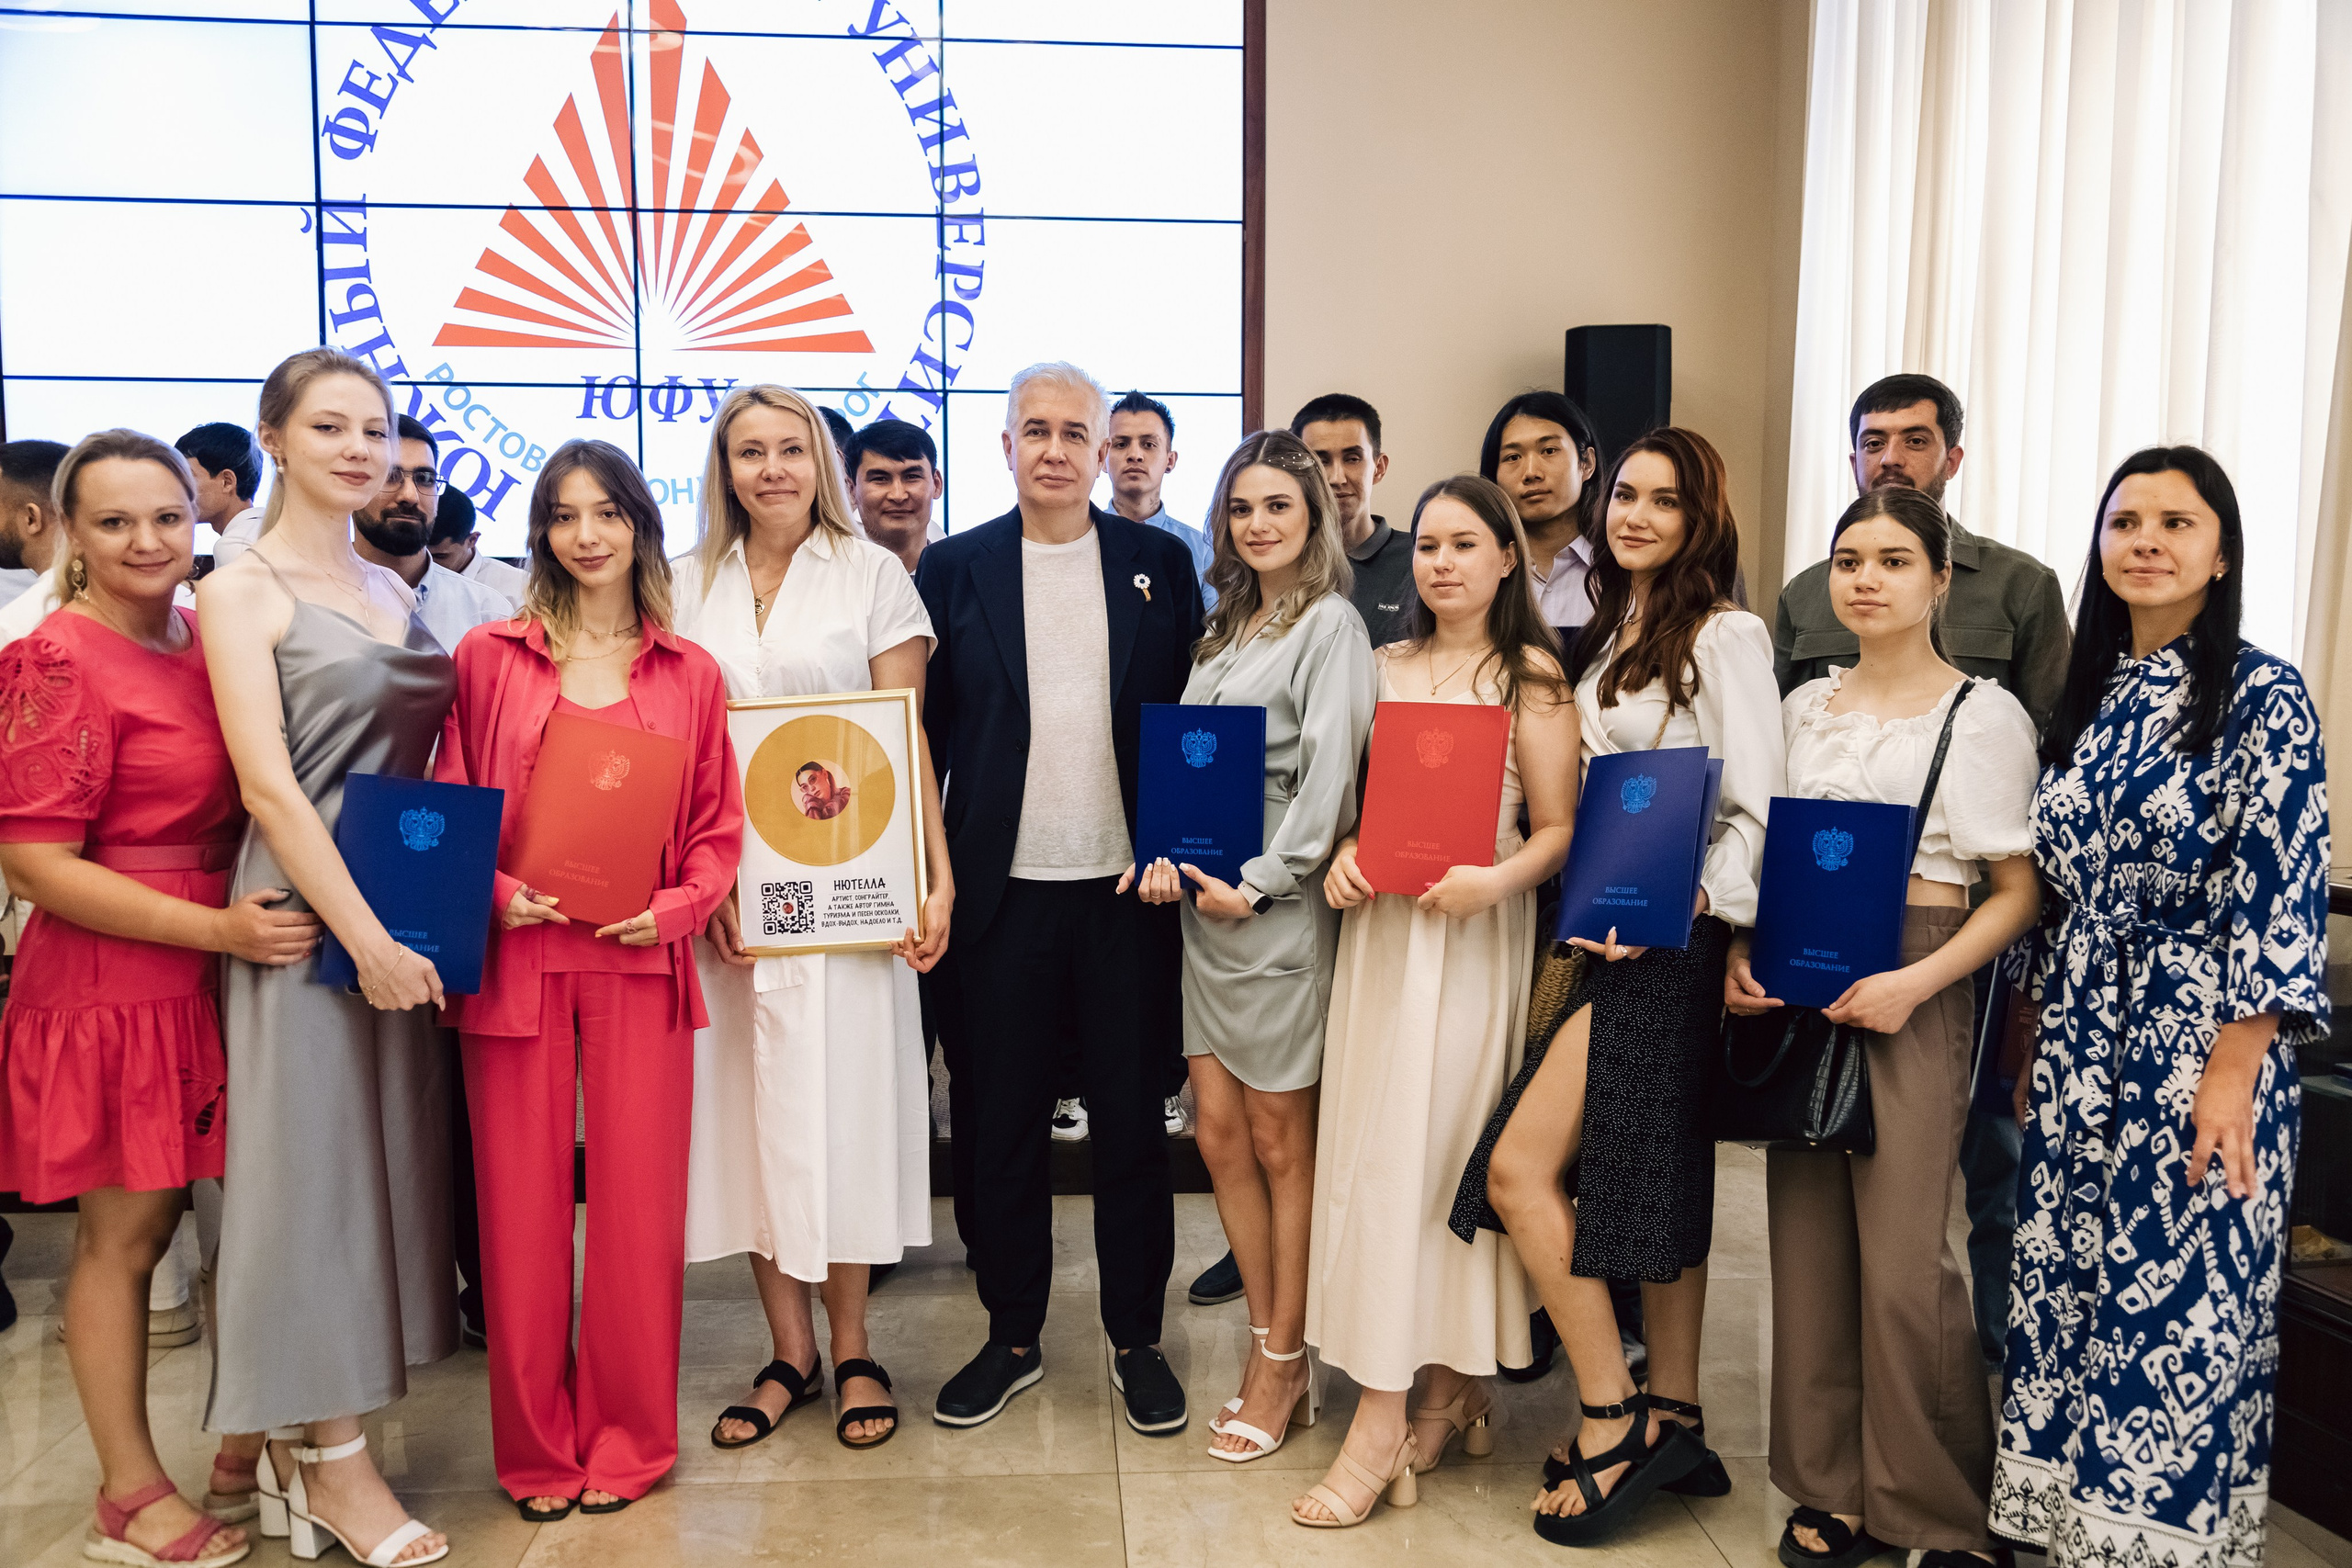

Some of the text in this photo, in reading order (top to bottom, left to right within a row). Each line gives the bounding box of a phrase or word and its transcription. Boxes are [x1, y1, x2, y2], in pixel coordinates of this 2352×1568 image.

[847, 0, 987, 430] УНИВЕРСИ
[576, 375, 739, 423] ЮФУ
[1182, 837, 1213, 845] ВЫСШЕЕ
[1407, 840, 1441, 851] ВЫСШЕЕ
[1170, 847, 1224, 856] ОБРАЗОВАНИЕ
[1395, 851, 1452, 863] ОБРАЗОВАНИЕ
[564, 859, 600, 874] ВЫСШЕЕ
[548, 868, 610, 888] ОБРАЗОВАНИЕ
[833, 877, 886, 891] НЮТЕЛЛА
[1605, 886, 1638, 895] ВЫСШЕЕ
[1592, 897, 1648, 907] ОБРАЗОВАНИЕ
[860, 918, 886, 926] НАДОЕЛО
[389, 929, 428, 939] ВЫСШЕЕ
[1803, 947, 1839, 959] ВЫСШЕЕ
[1789, 958, 1850, 974] ОБРАЗОВАНИЕ
